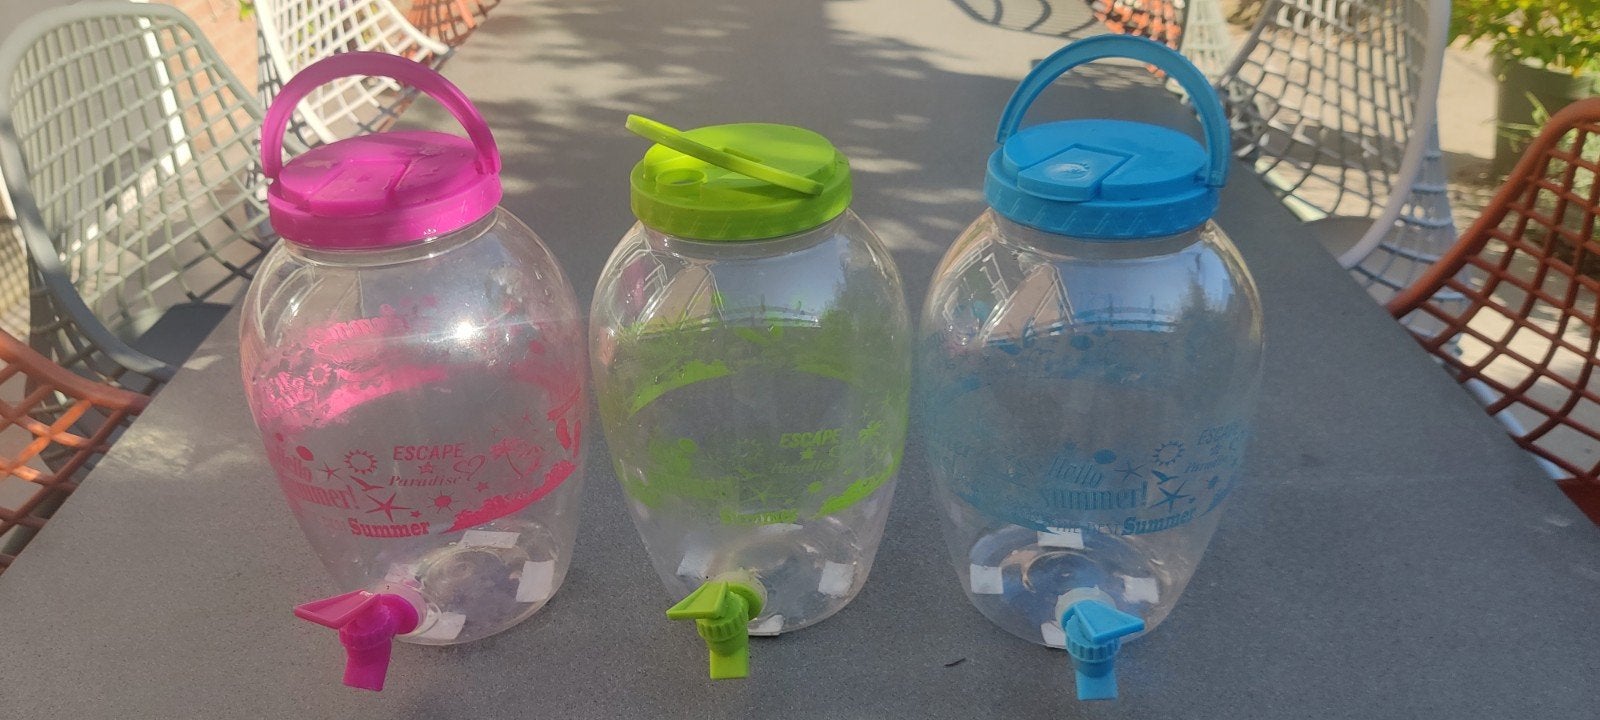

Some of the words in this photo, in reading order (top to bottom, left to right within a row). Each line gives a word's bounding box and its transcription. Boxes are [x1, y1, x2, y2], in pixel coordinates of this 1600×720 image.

[779, 428, 841, 448] ESCAPE
[393, 443, 464, 461] ESCAPE
[389, 475, 461, 487] Paradise
[347, 518, 430, 537] Summer
[1121, 506, 1197, 536] Summer
